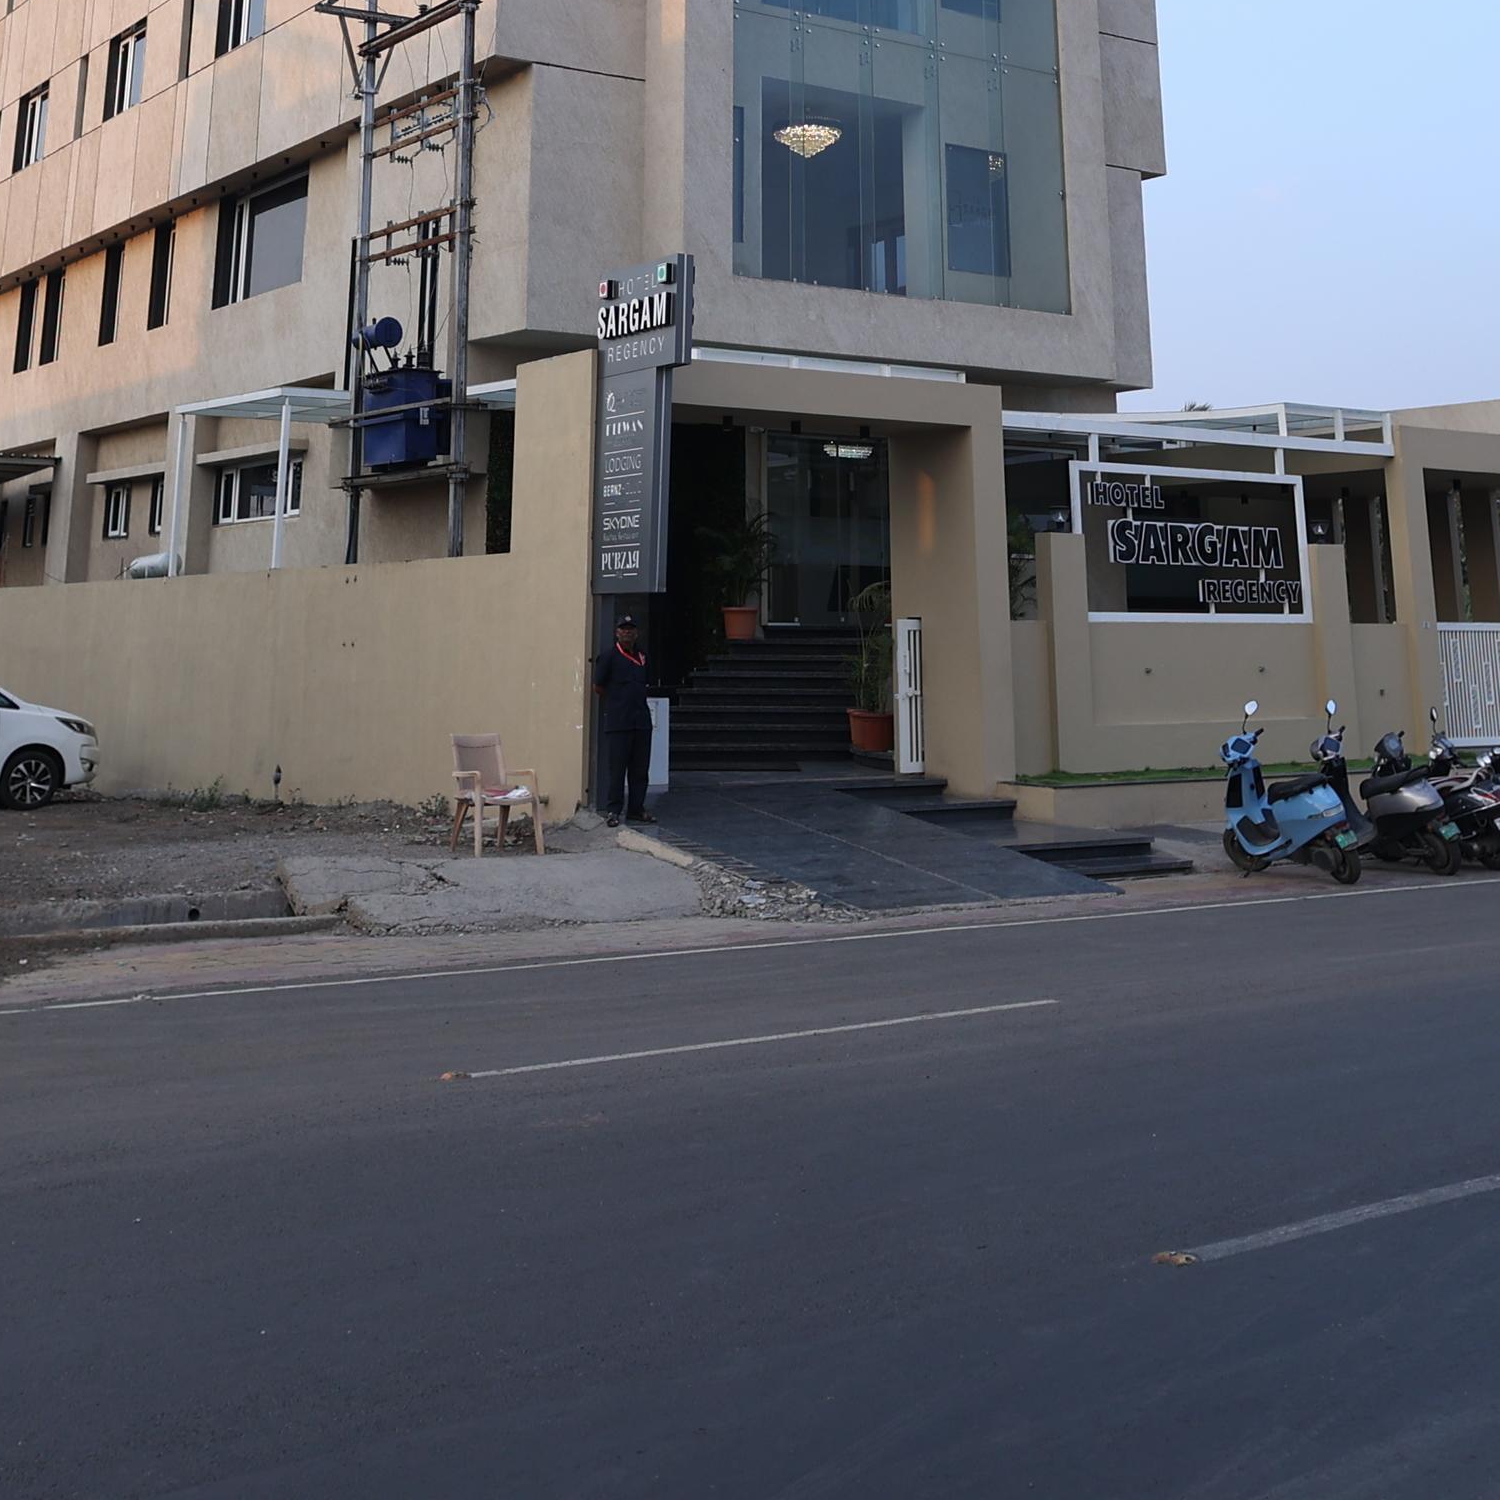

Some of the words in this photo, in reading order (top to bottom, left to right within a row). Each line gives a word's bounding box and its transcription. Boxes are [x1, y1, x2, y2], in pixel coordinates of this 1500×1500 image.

[618, 272, 658, 297] HOTEL
[597, 291, 668, 340] SARGAM
[607, 336, 666, 363] REGENCY
[604, 454, 642, 474] LODGING
[1091, 481, 1166, 510] HOTEL
[1109, 518, 1285, 570] SARGAM
[1202, 578, 1302, 605] REGENCY
